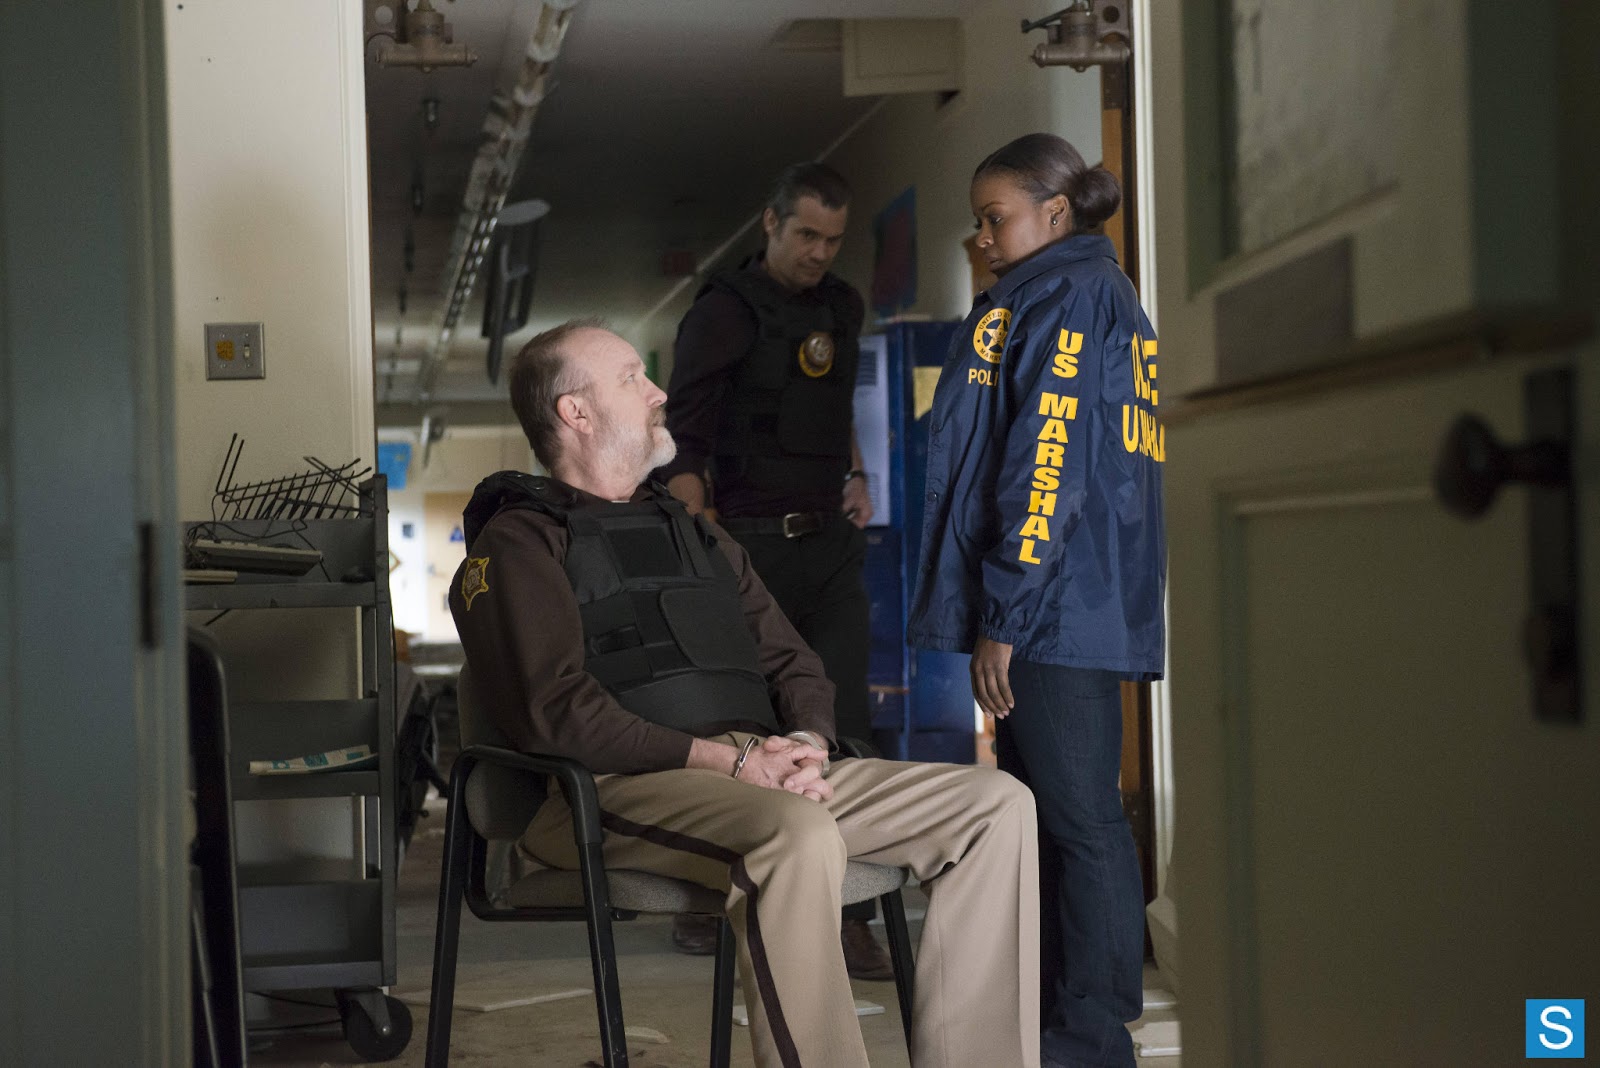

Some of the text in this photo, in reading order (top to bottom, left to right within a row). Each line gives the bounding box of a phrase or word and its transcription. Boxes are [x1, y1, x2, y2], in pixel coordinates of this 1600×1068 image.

[979, 311, 1003, 330] UNITED
[968, 368, 999, 387] POLI
[1018, 328, 1084, 565] US MARSHAL
